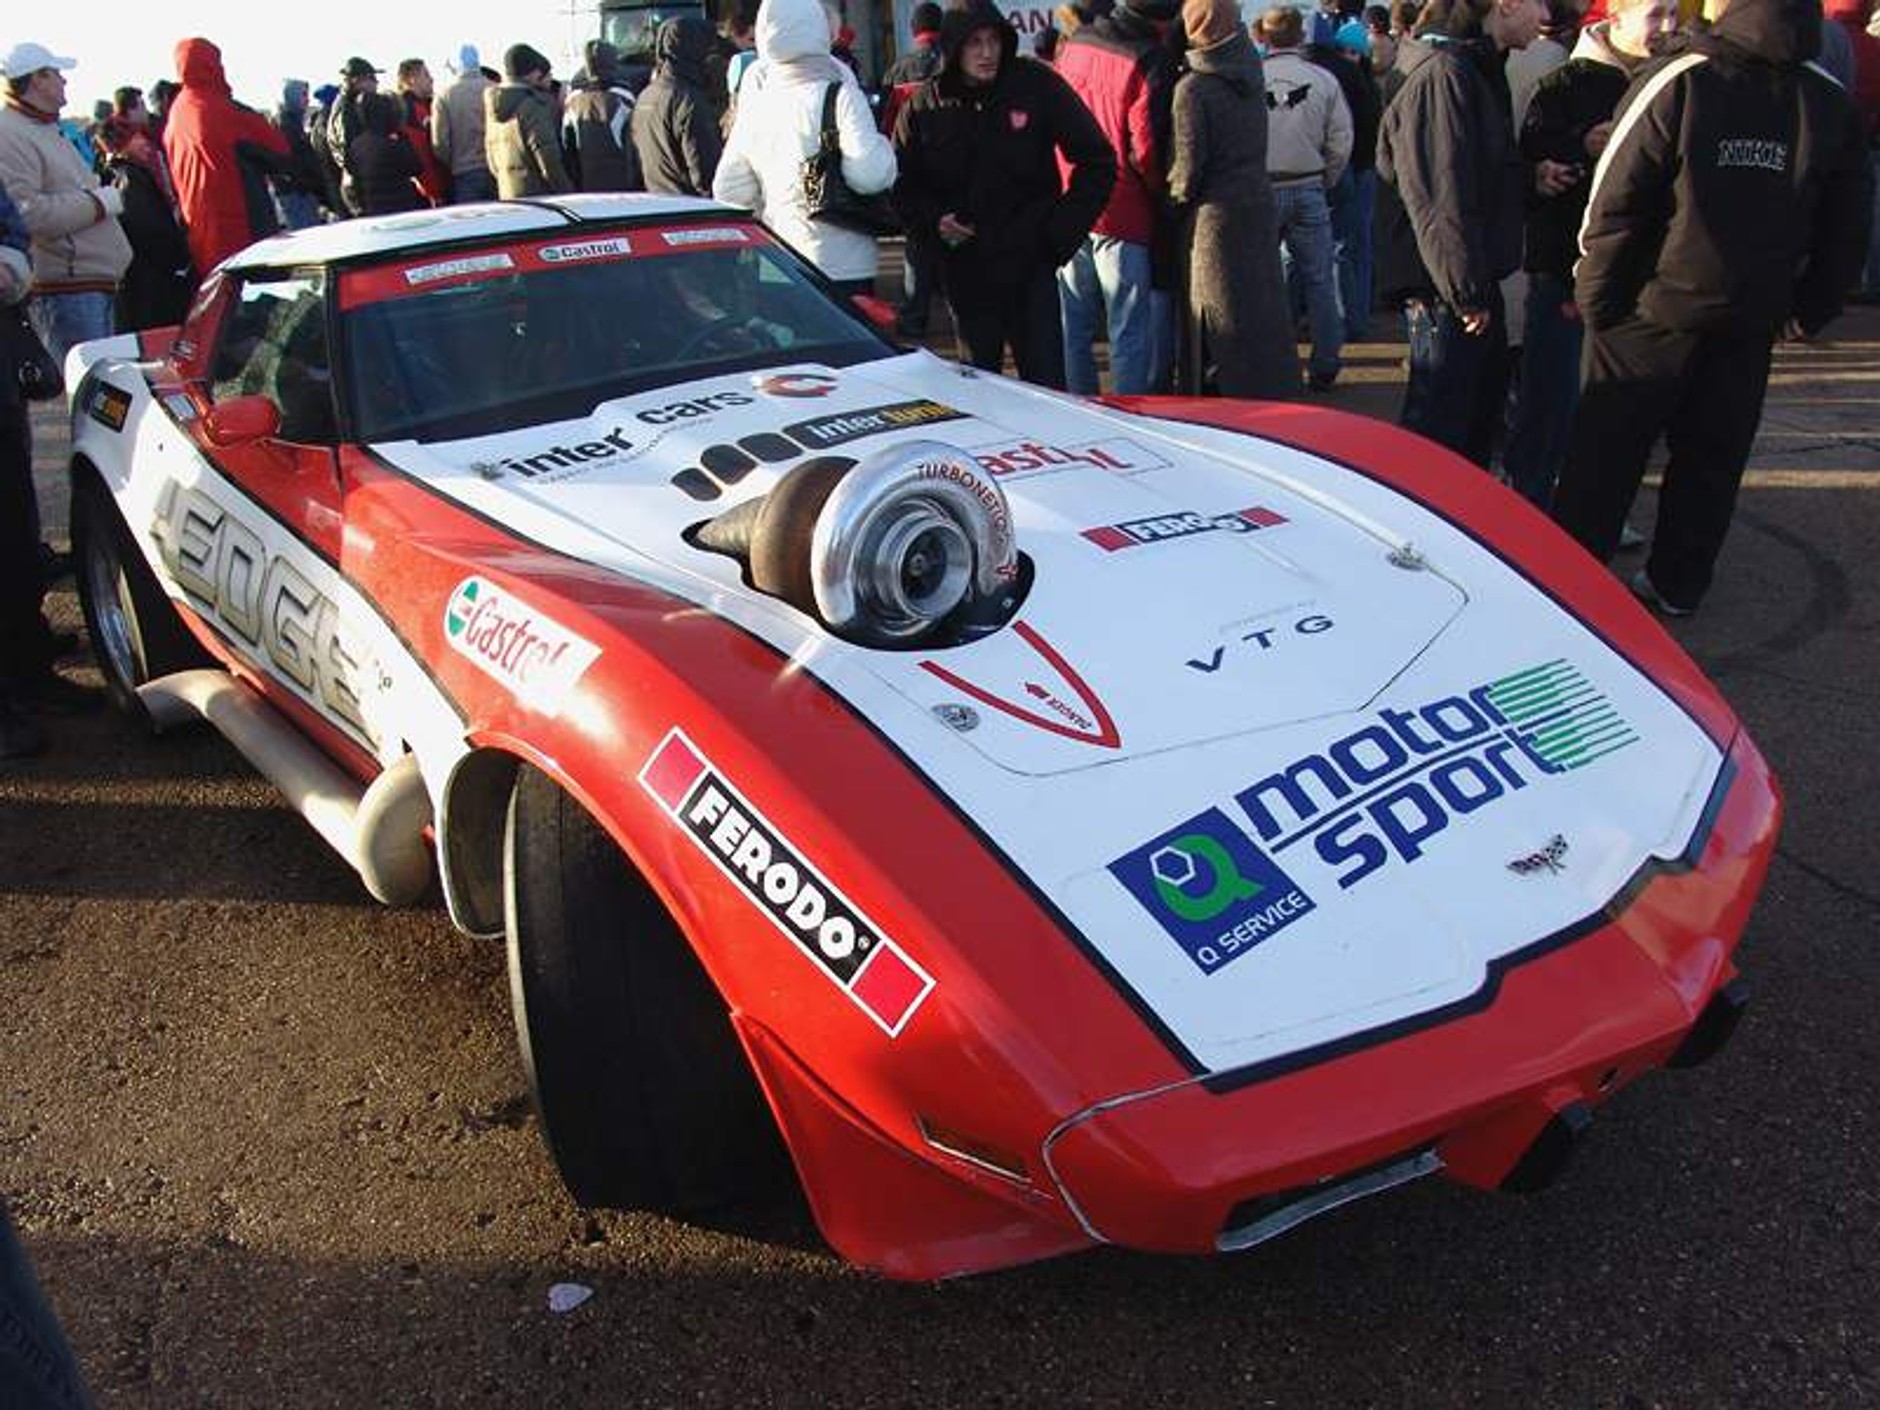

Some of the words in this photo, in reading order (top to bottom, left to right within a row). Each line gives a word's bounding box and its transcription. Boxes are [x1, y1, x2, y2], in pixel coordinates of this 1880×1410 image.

[1718, 139, 1787, 170] NIKE
[561, 241, 621, 257] Castrol
[502, 427, 634, 478] inter
[636, 391, 754, 425] cars
[1234, 683, 1512, 843] motor
[1313, 727, 1567, 890] sport
[688, 784, 858, 960] FERODO
[1197, 946, 1222, 966] Q
[1218, 890, 1308, 953] SERVICE
